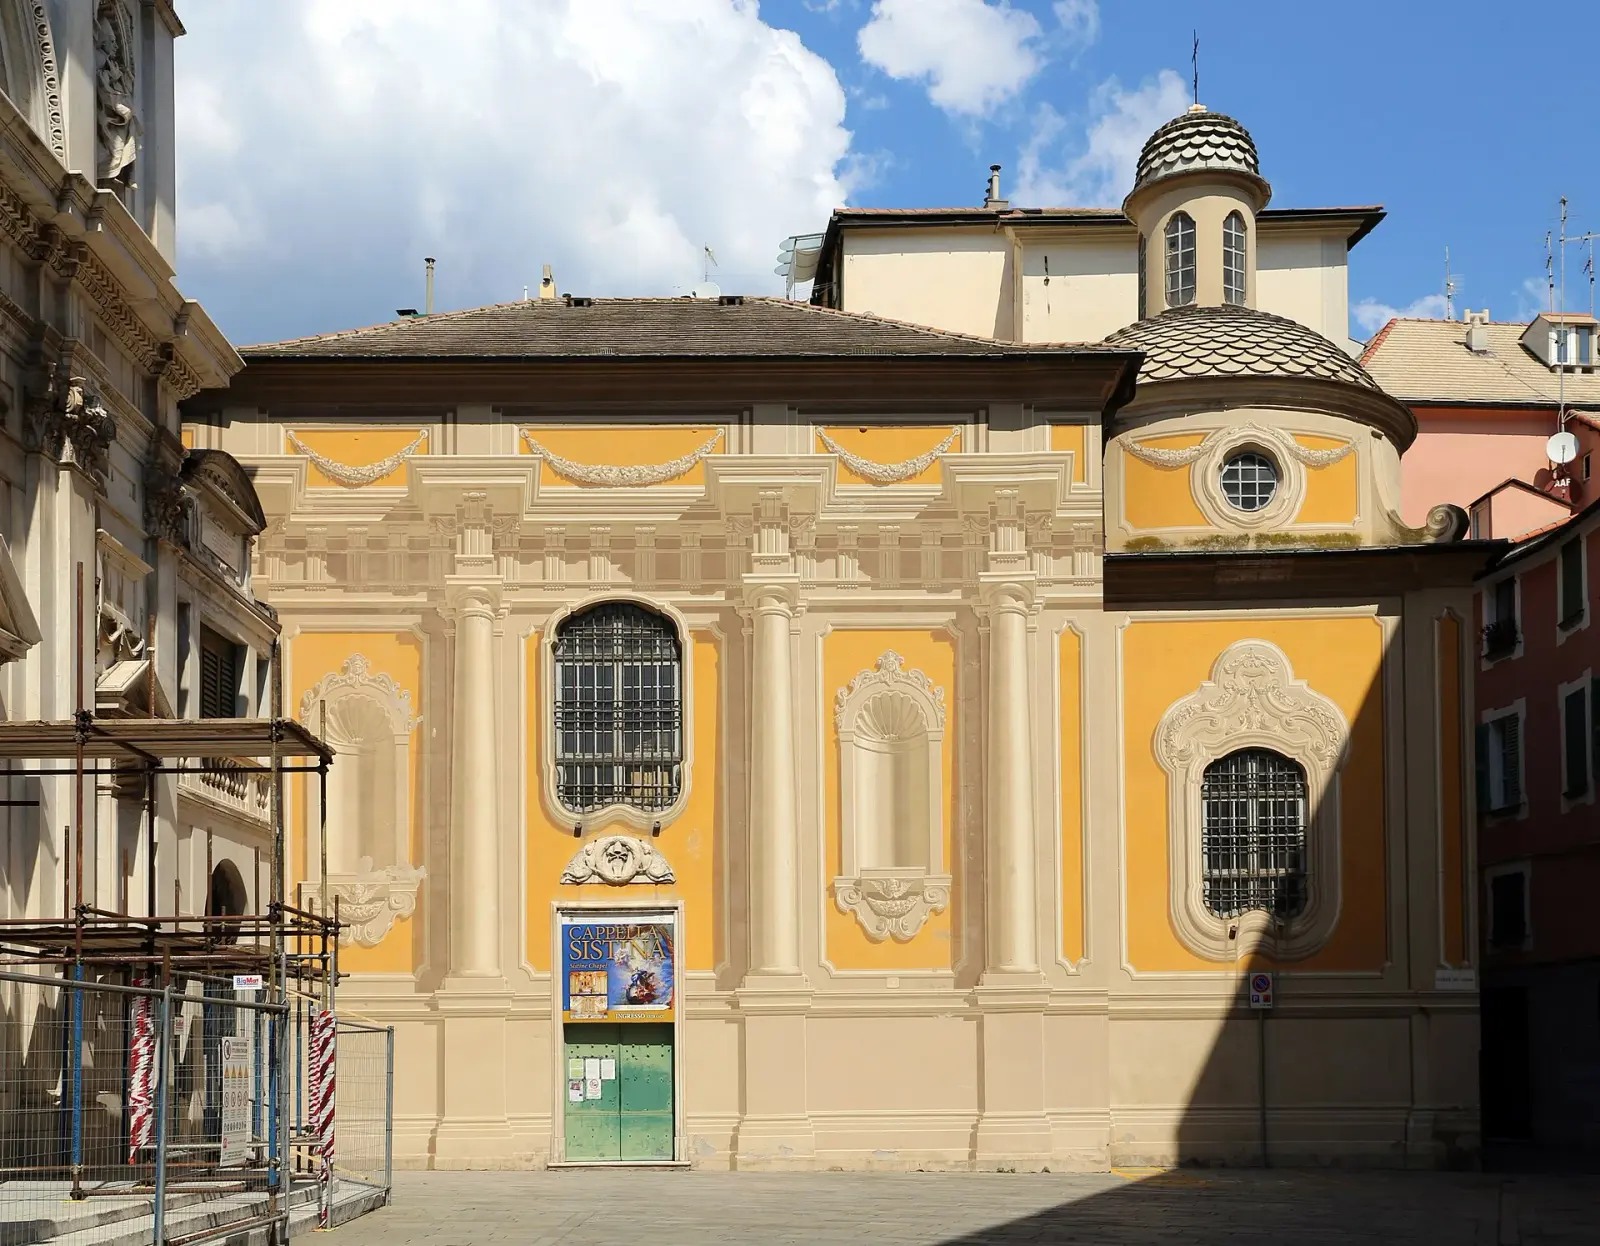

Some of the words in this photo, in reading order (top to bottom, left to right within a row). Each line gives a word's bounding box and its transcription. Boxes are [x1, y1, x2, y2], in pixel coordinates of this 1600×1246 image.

[569, 926, 658, 940] CAPPELLA
[569, 940, 666, 960] SISTINA
[589, 962, 608, 971] Chapel
[236, 977, 259, 985] BigMat
